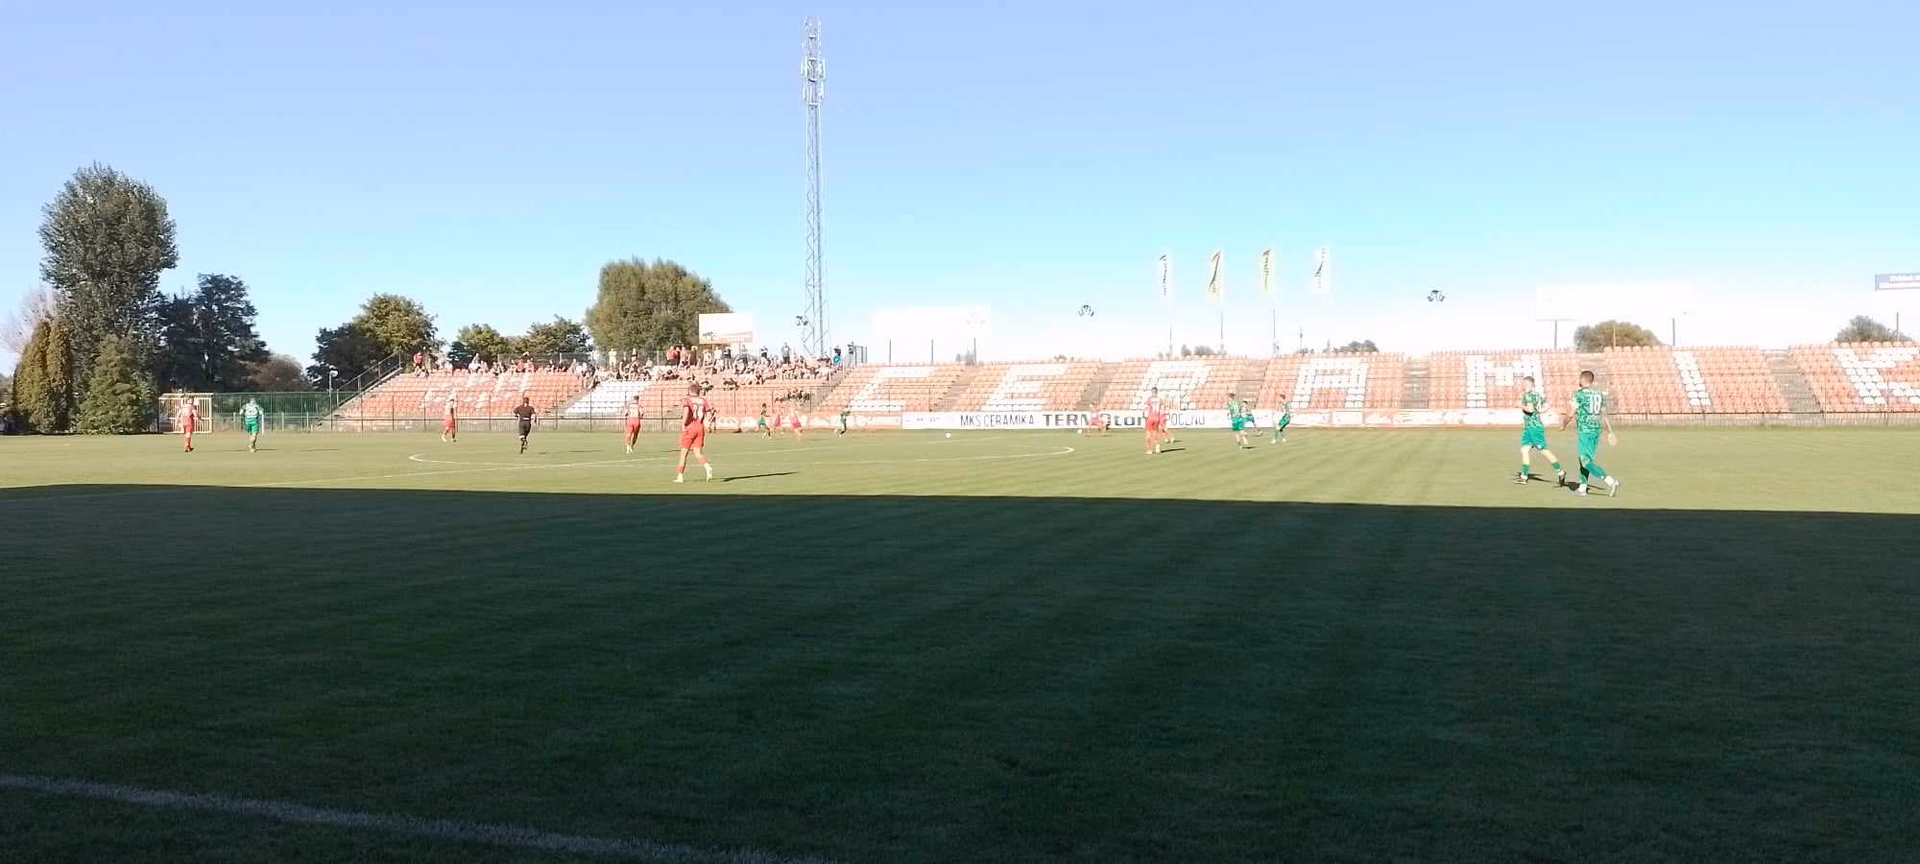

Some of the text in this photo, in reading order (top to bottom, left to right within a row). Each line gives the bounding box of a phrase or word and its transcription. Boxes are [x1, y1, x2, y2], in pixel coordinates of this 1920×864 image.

[1587, 394, 1603, 414] 18
[960, 414, 981, 428] MKS
[983, 414, 1035, 427] CERAMIKA
